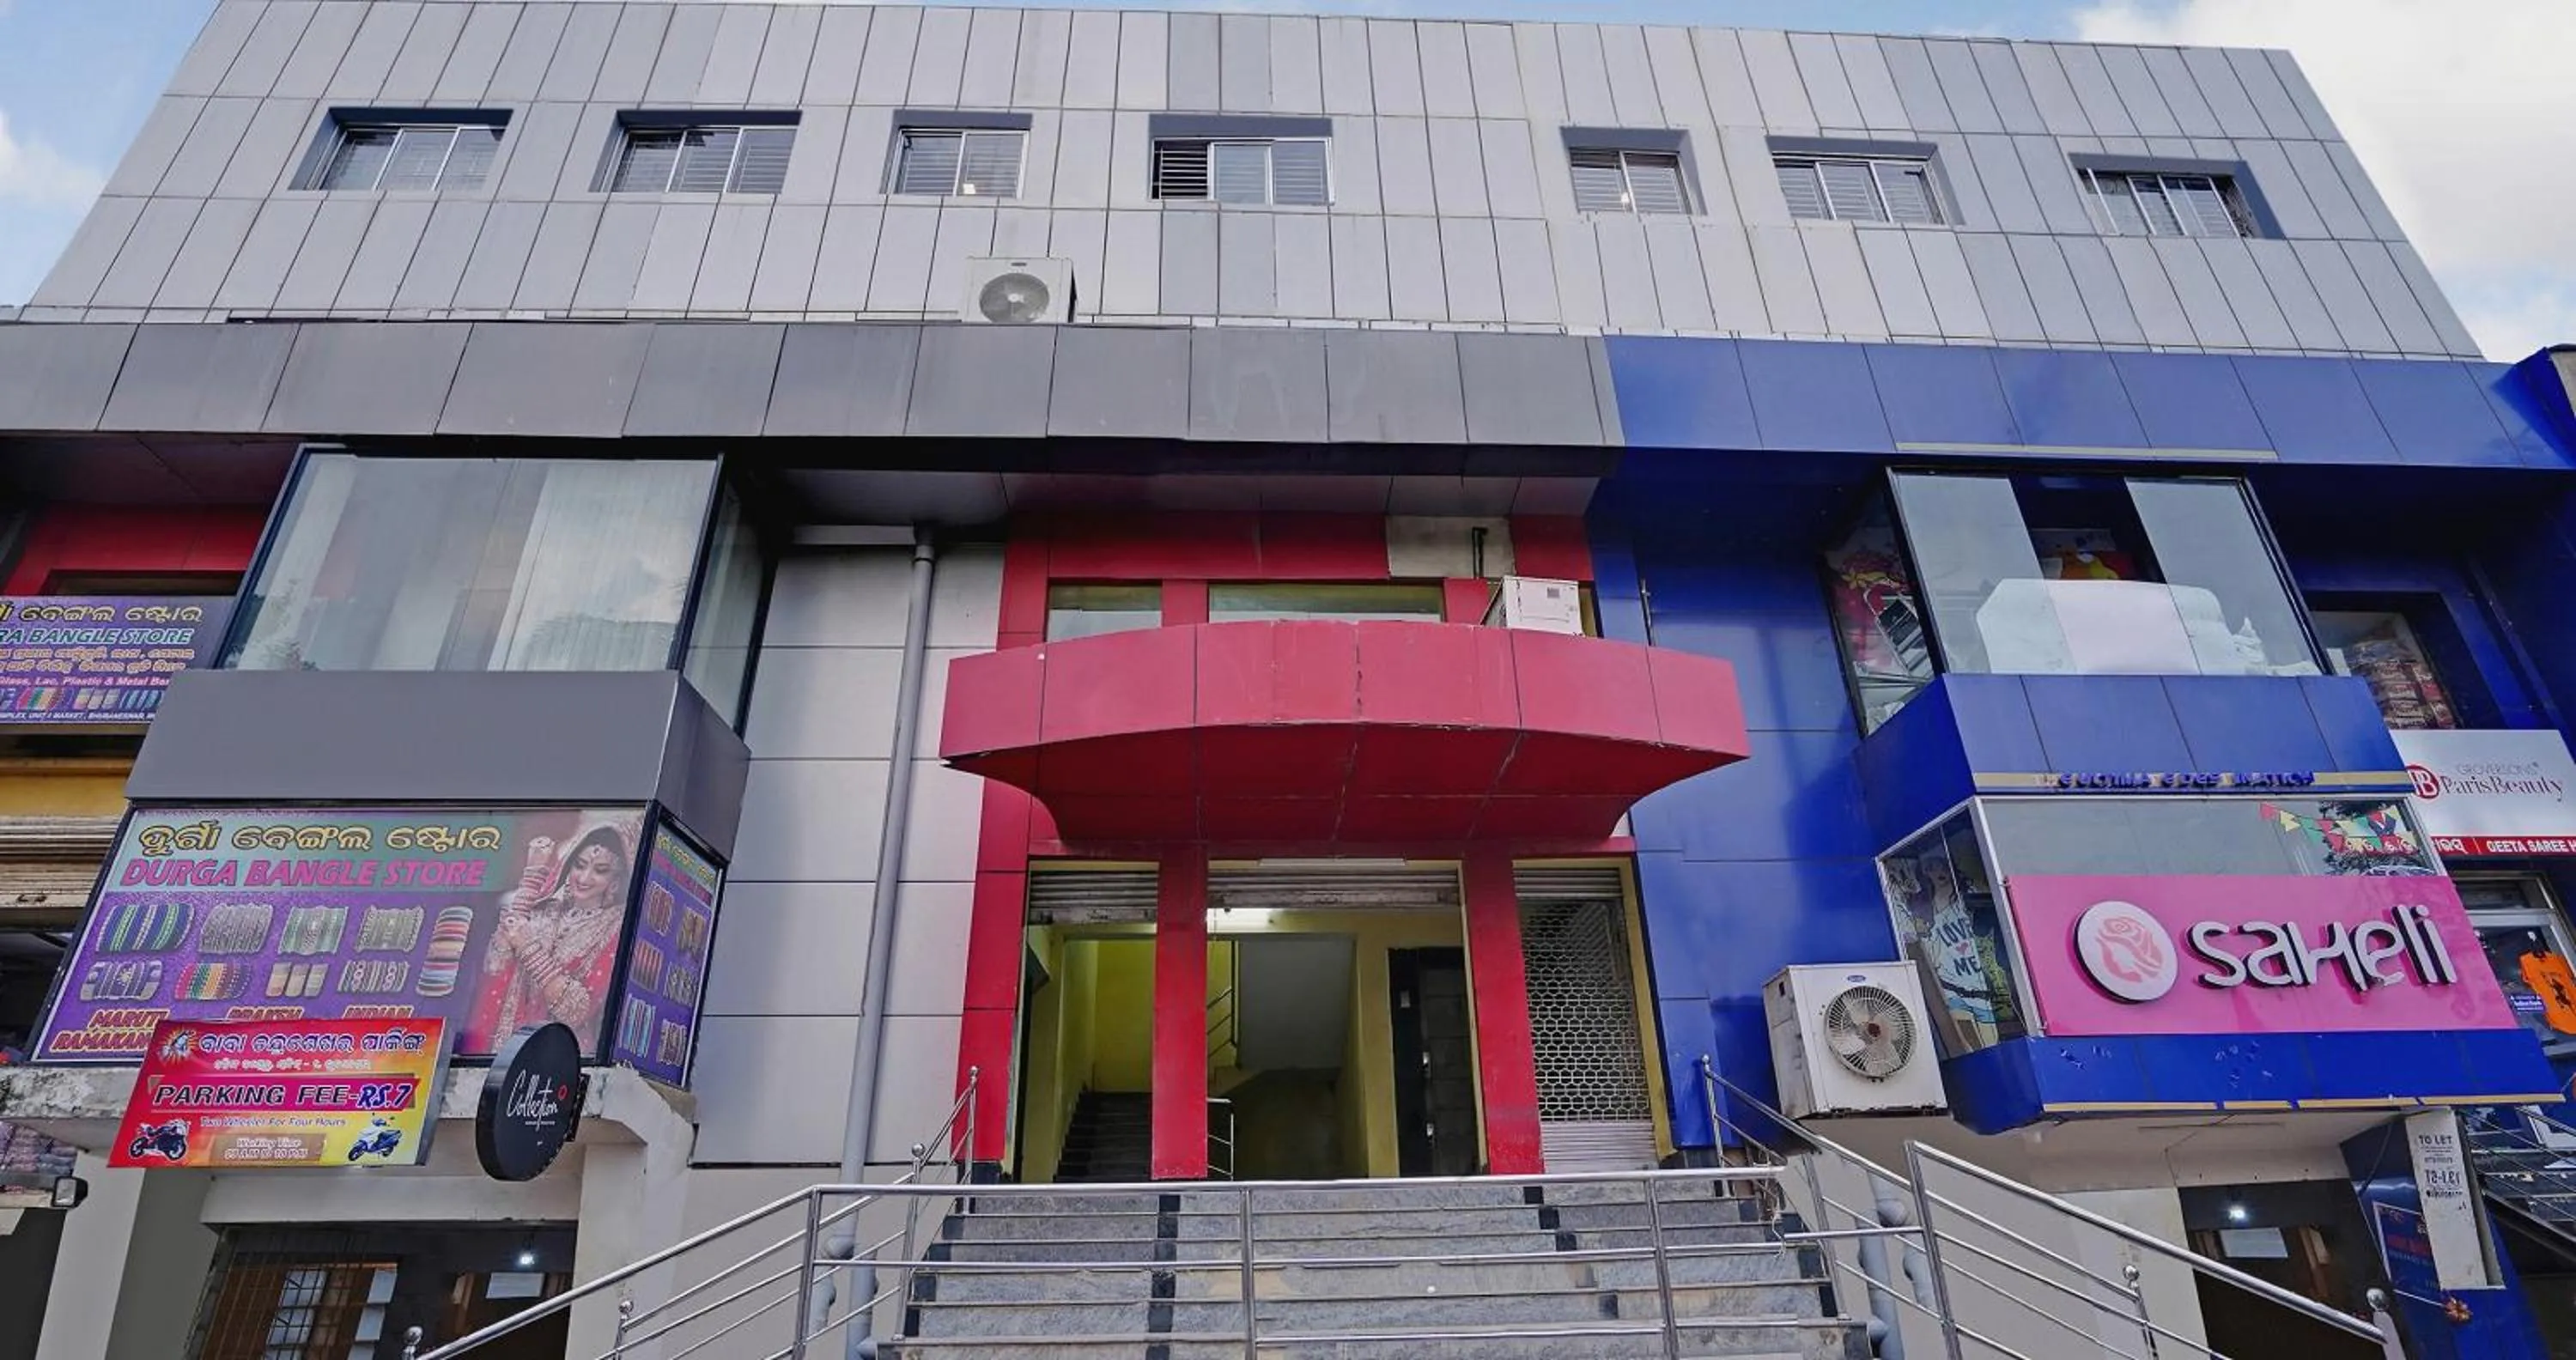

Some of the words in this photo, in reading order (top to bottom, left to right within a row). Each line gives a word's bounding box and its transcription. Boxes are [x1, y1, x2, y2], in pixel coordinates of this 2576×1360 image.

[28, 628, 121, 645] BANGLE
[121, 628, 194, 645] STORE
[121, 859, 236, 887] DURGA
[244, 859, 375, 887] BANGLE
[383, 859, 489, 887] STORE
[1936, 917, 1974, 948] LOVE
[1953, 956, 1982, 977] ME
[152, 1084, 285, 1106] PARKING
[507, 1069, 558, 1132] Collection
[268, 1117, 285, 1126] For
[315, 1117, 346, 1126] Hours
[2419, 1134, 2432, 1144] TO
[2435, 1134, 2452, 1144] LET
